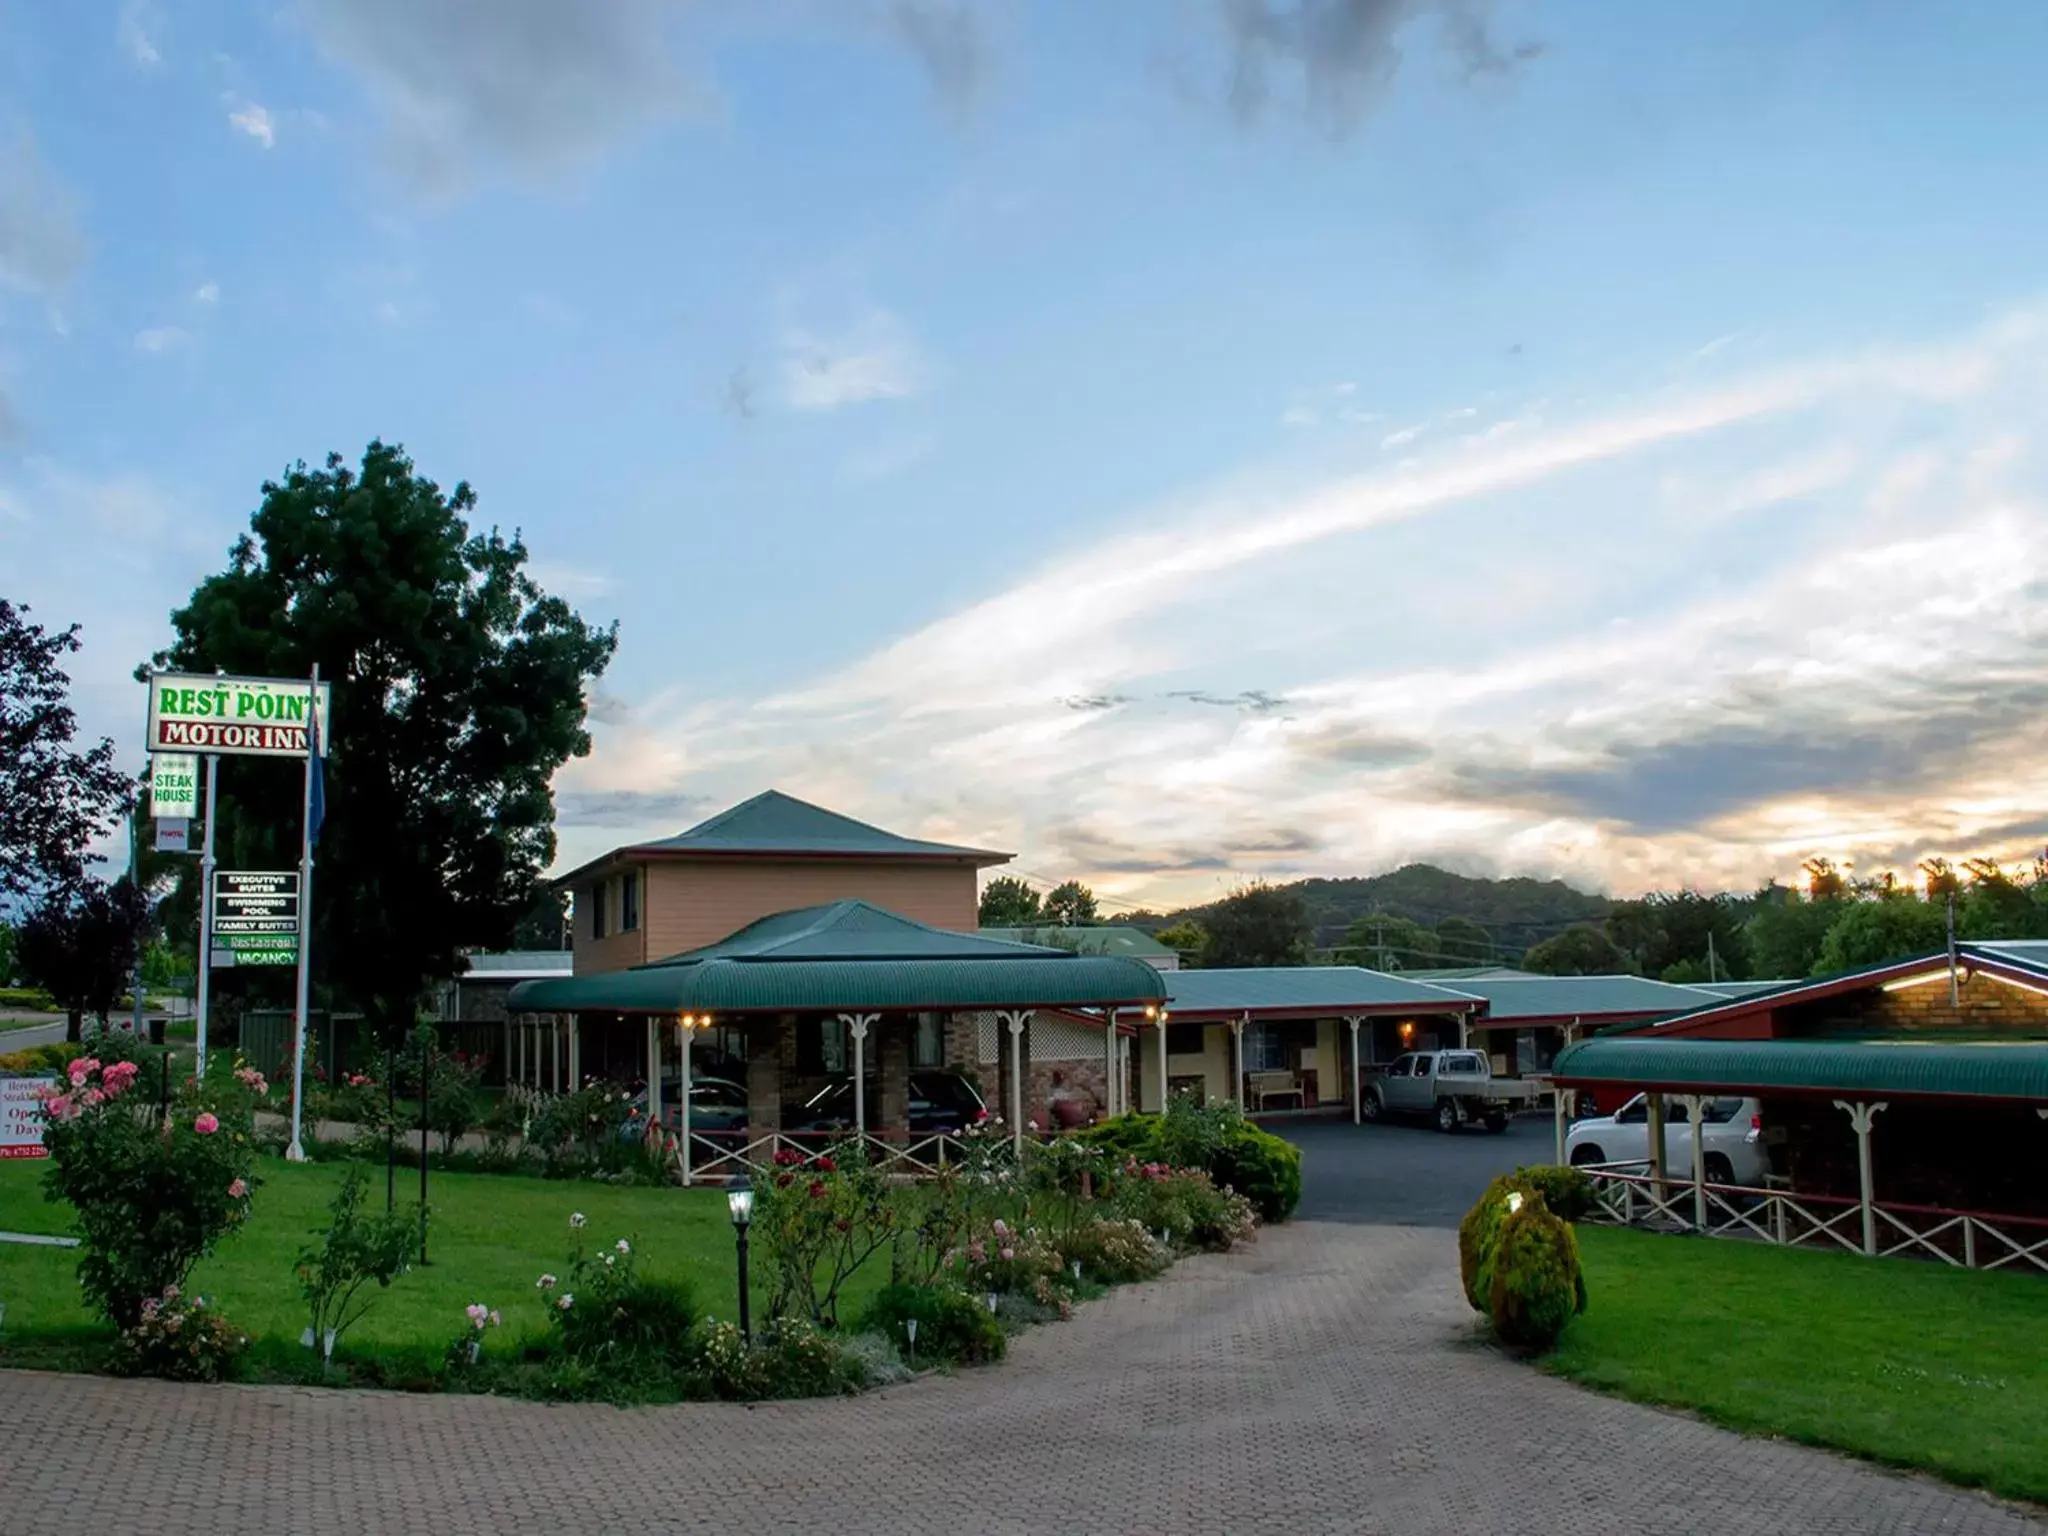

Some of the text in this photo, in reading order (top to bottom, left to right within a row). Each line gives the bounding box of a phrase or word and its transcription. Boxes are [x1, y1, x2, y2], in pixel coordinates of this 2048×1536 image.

[160, 688, 230, 717] REST
[166, 723, 261, 748] MOTOR
[155, 774, 193, 788] STEAK
[154, 789, 193, 803] HOUSE
[242, 907, 271, 915] POOL
[236, 952, 297, 965] VACANCY
[4, 1125, 12, 1135] 7
